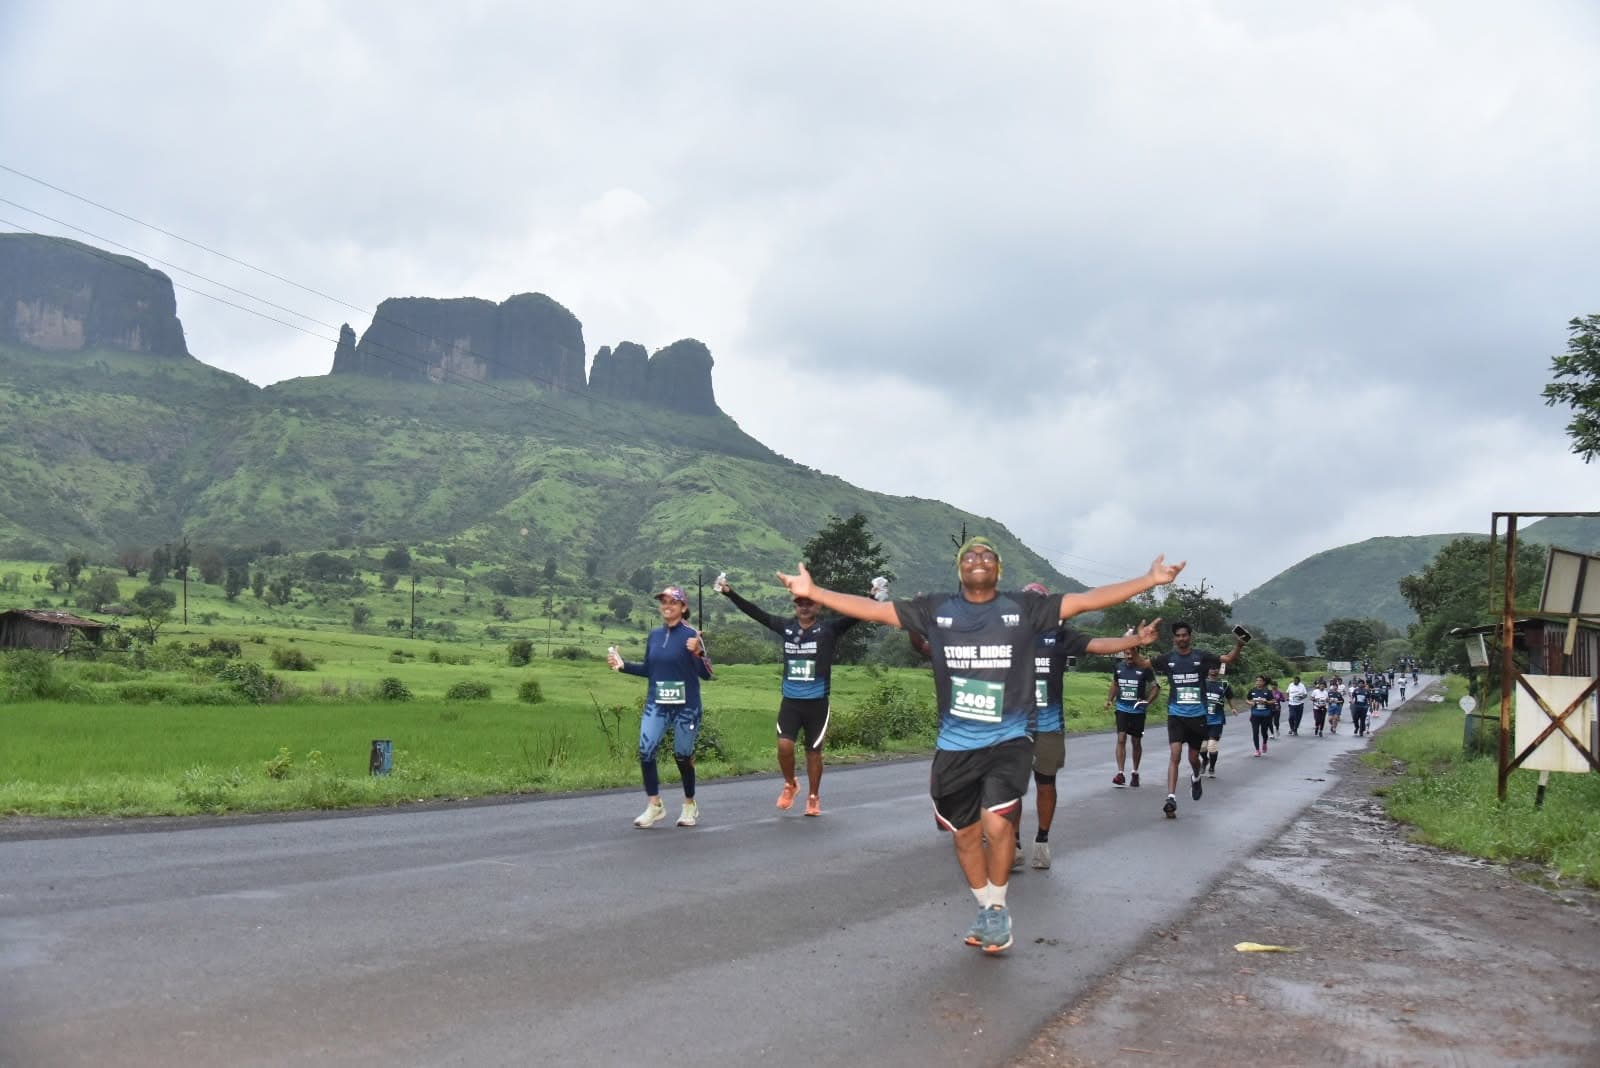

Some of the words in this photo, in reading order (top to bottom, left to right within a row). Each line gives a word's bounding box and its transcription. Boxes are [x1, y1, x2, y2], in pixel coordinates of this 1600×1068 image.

[1001, 614, 1020, 623] TRI
[944, 646, 978, 659] STONE
[980, 645, 1013, 658] RIDGE
[659, 688, 680, 697] 2371
[956, 691, 996, 710] 2405
